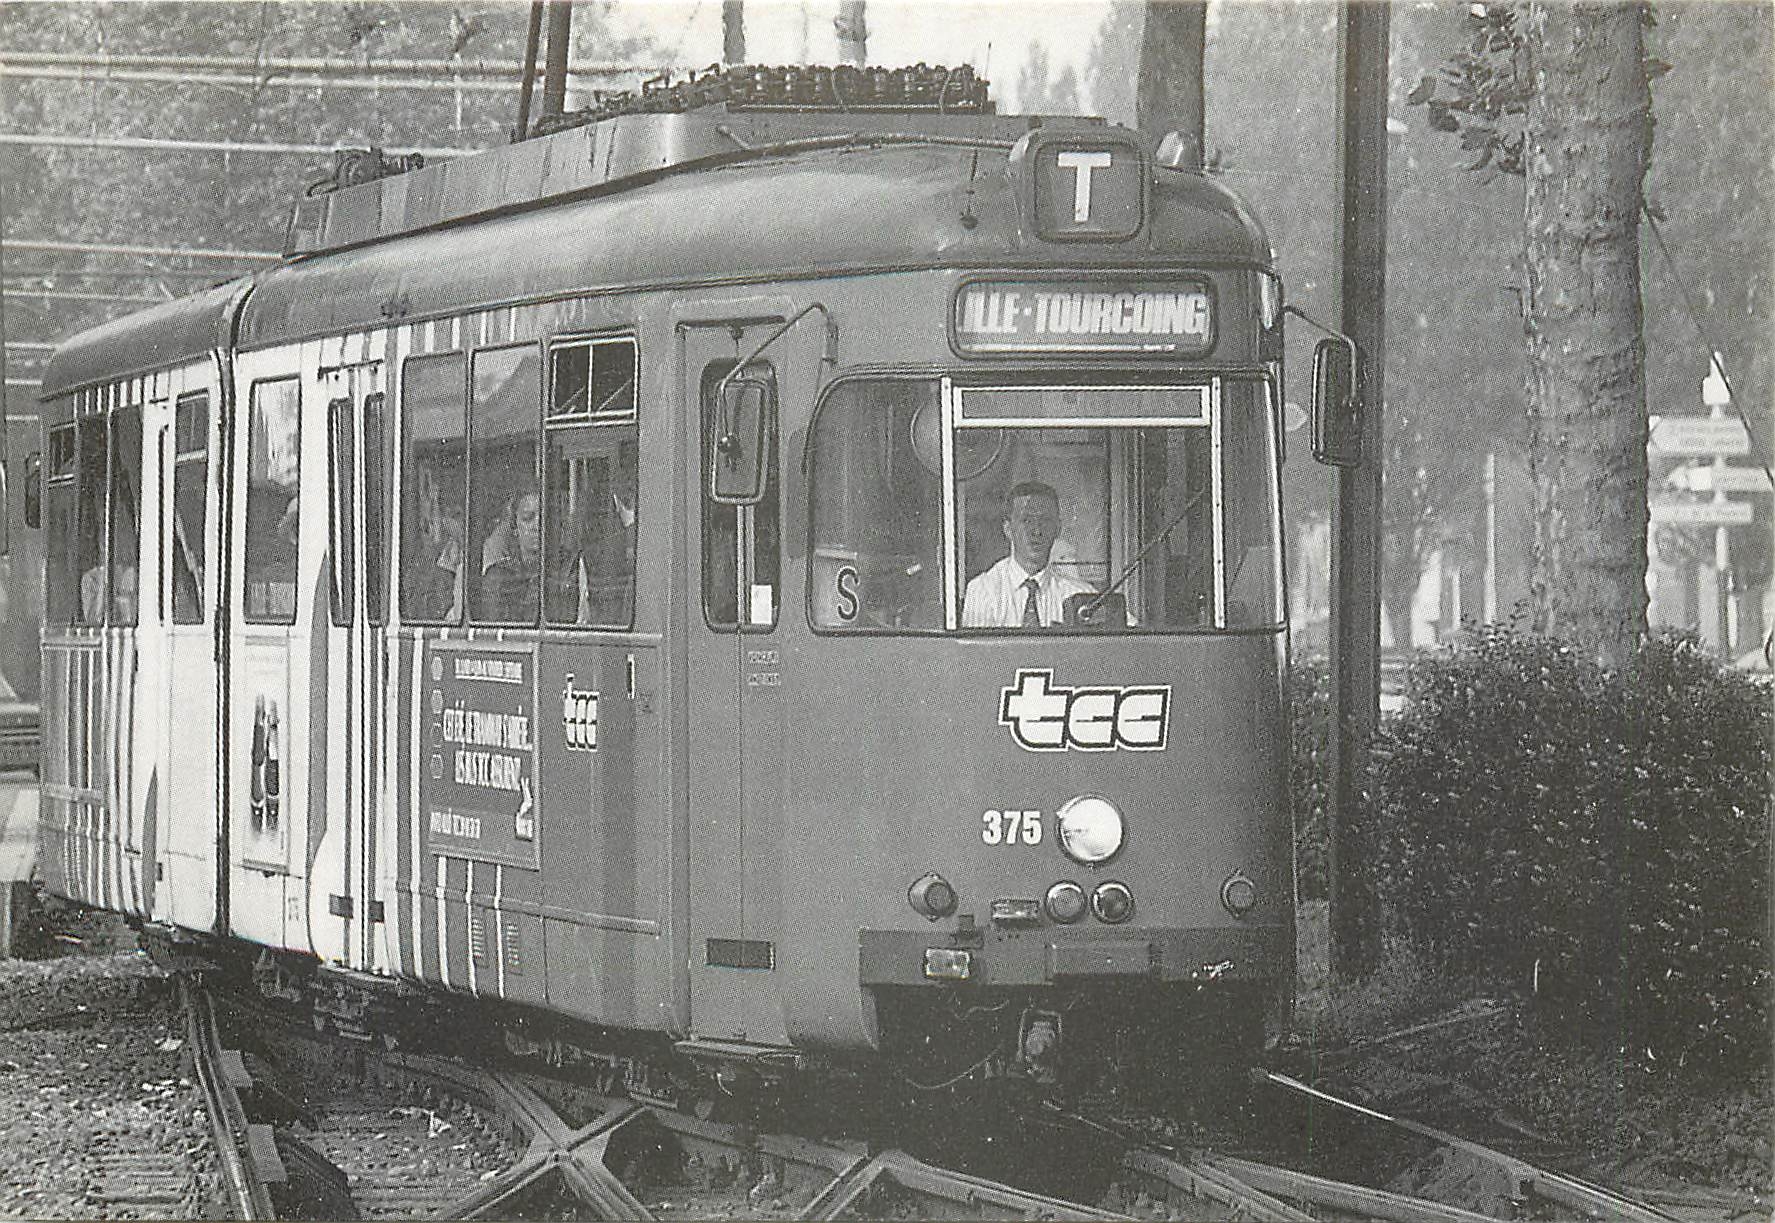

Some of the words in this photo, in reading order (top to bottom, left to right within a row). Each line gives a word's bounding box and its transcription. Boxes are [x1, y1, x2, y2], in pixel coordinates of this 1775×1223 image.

[1057, 151, 1112, 222] T
[957, 291, 1209, 334] ILLE-TOURCOING
[837, 565, 860, 622] S
[999, 668, 1171, 751] tcc
[982, 810, 1042, 845] 375
